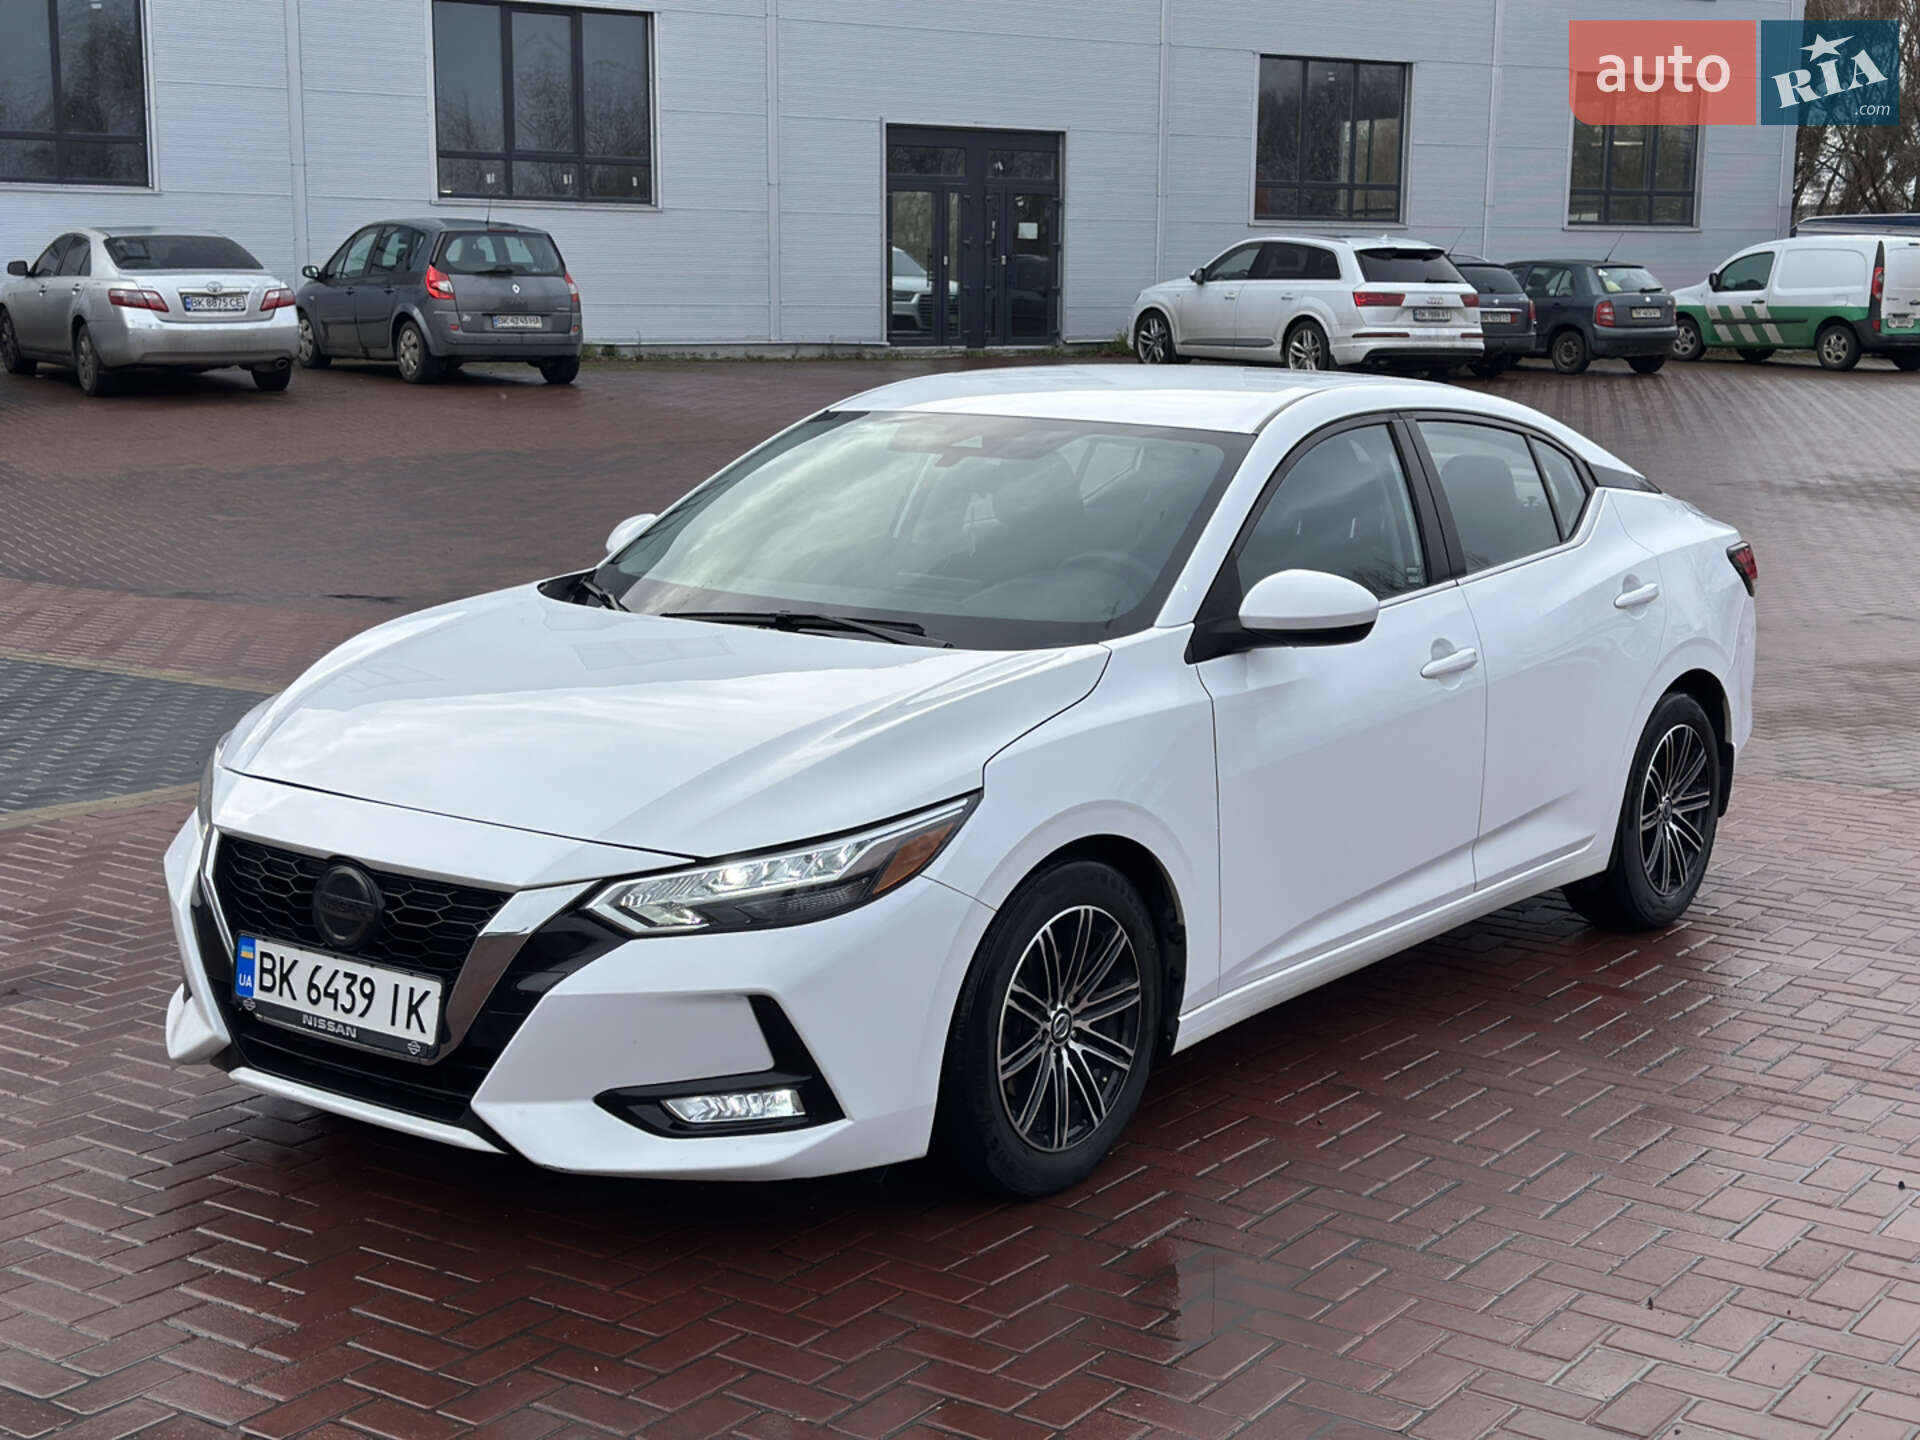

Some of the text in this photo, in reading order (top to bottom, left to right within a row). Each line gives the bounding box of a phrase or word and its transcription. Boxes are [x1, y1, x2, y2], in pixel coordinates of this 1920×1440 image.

[229, 296, 243, 308] CE
[239, 973, 252, 988] UA
[259, 951, 431, 1034] BK 6439 IK
[302, 1013, 358, 1039] NISSAN
